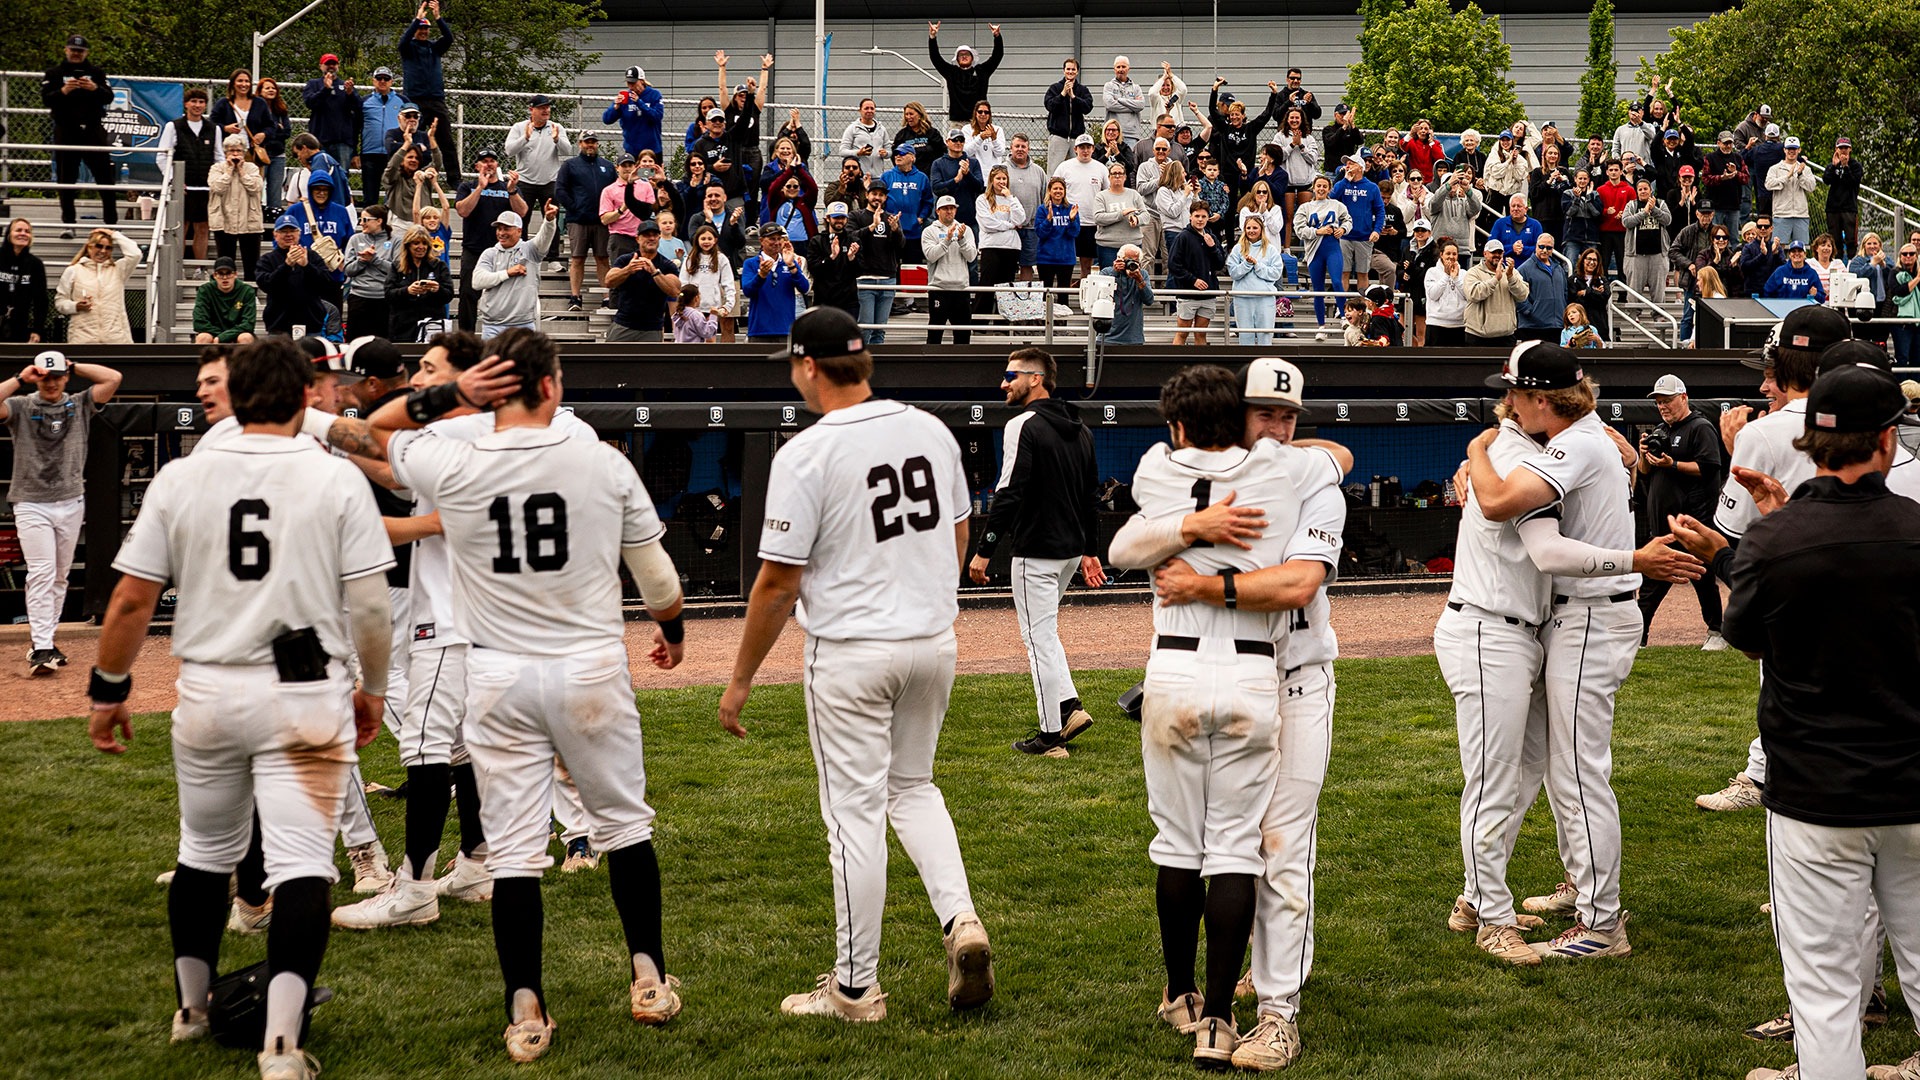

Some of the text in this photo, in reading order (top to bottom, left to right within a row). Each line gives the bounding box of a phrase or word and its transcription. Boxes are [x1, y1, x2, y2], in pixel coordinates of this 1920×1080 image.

[101, 117, 140, 125] ASEBALL
[1052, 215, 1070, 226] NTLE
[46, 357, 55, 368] B
[1273, 369, 1291, 393] B
[786, 409, 794, 419] B
[974, 408, 981, 418] B
[1107, 408, 1114, 418] B
[1340, 406, 1346, 415] B
[1400, 405, 1407, 415] B
[1458, 405, 1466, 414] B
[1614, 406, 1620, 415] B
[181, 412, 191, 422] B
[640, 410, 647, 420] B
[867, 456, 941, 543] 29
[1191, 478, 1215, 548] 1
[489, 492, 569, 574] 18
[229, 498, 270, 581] 6
